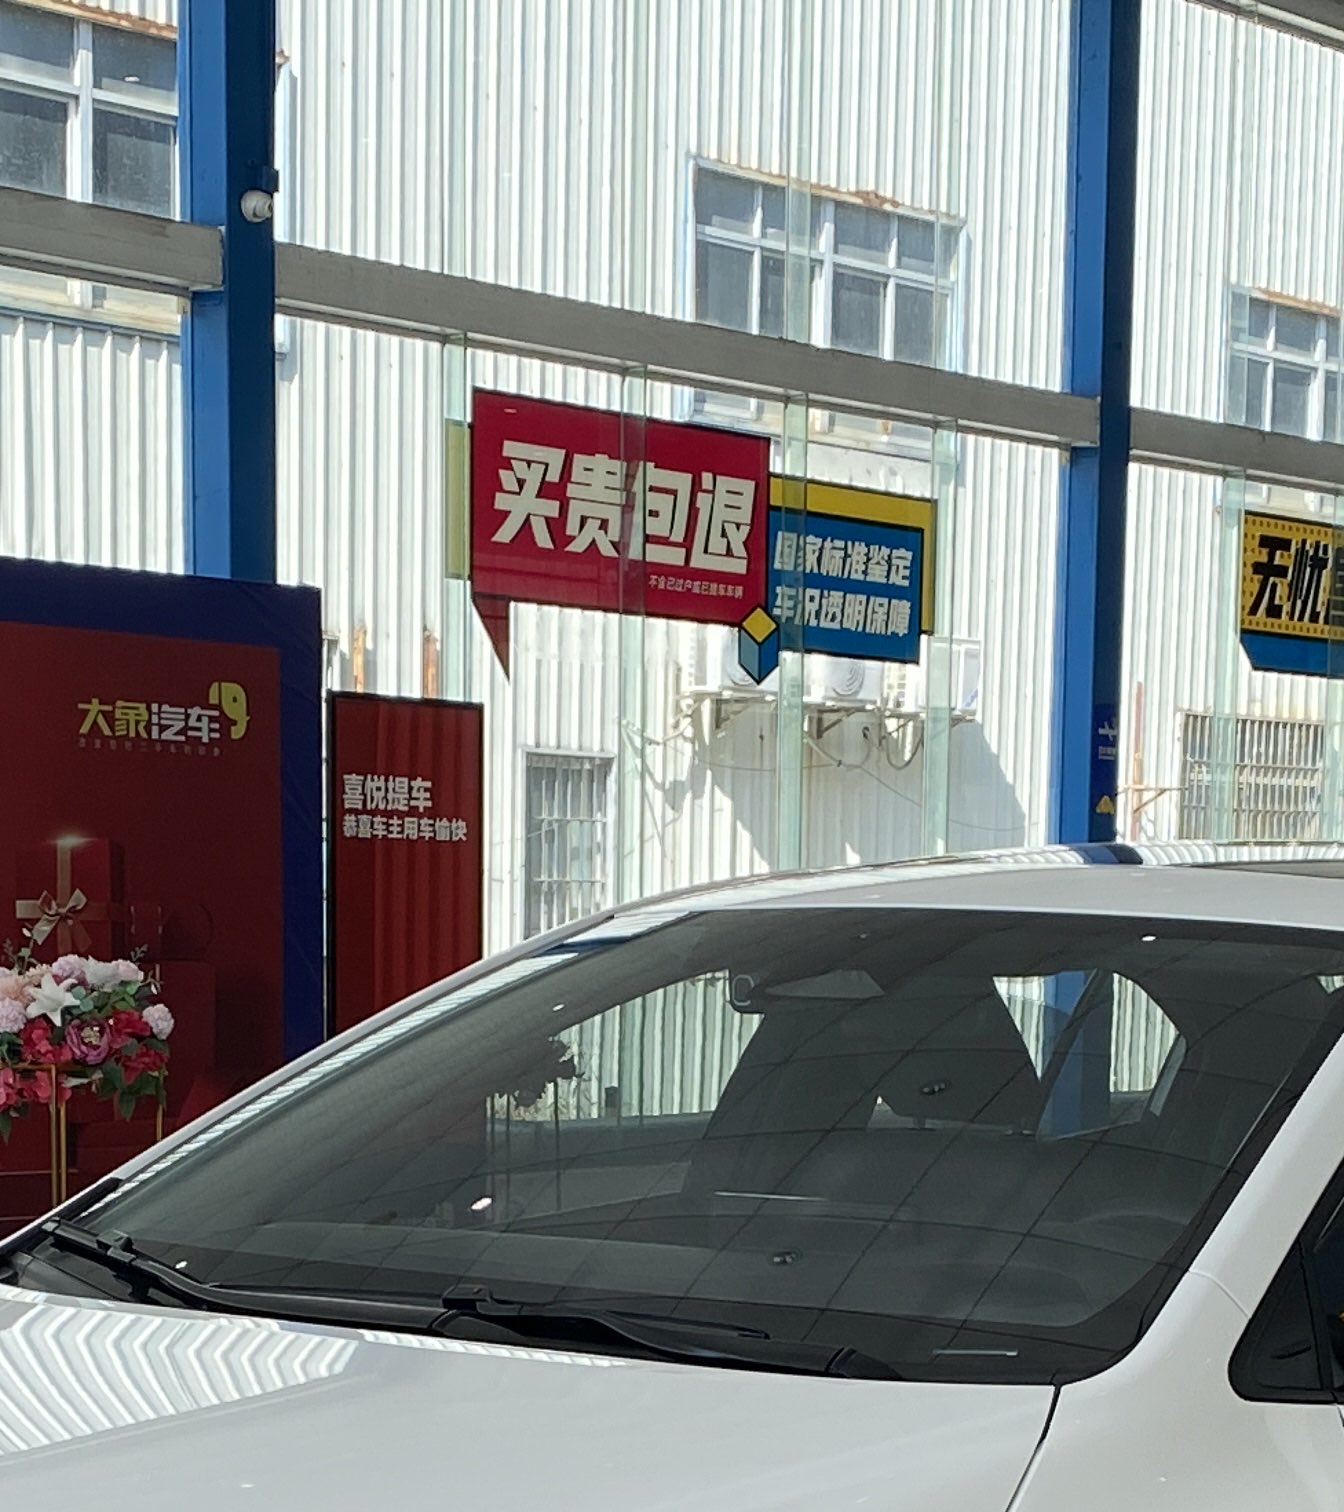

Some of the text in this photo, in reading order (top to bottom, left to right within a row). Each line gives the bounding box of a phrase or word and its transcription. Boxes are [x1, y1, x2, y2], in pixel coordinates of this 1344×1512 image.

[491, 440, 756, 575] 买贵包退
[773, 530, 914, 588] 国家标准鉴定
[772, 585, 912, 638] 车况透明保障
[77, 698, 221, 743] 大象汽车
[342, 773, 433, 813] 喜悦提车
